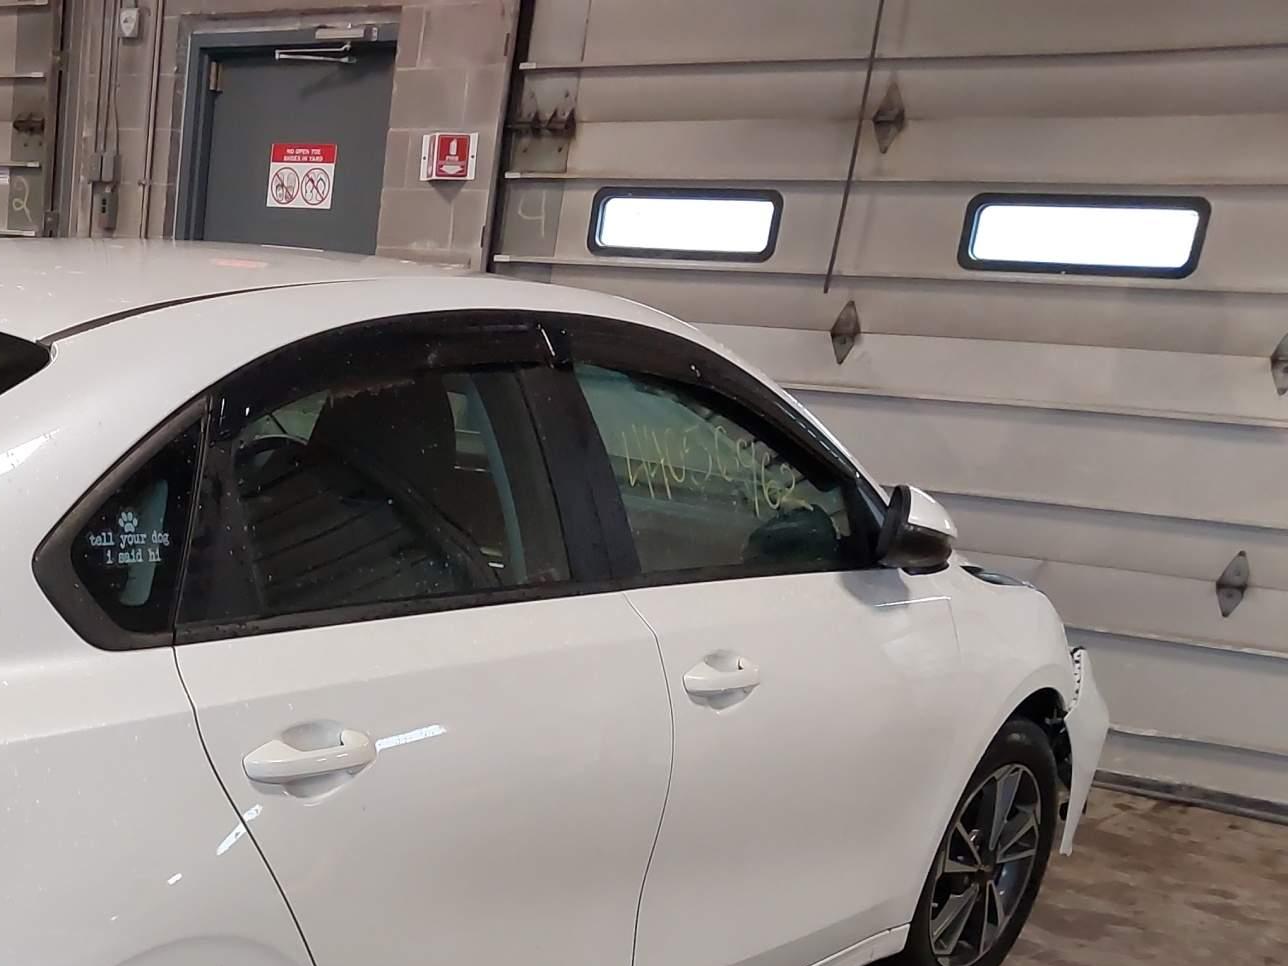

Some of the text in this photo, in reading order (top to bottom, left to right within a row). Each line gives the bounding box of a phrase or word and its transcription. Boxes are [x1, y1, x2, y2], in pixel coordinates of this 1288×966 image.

[89, 530, 170, 549] tell your dog
[106, 547, 162, 565] i said hi
